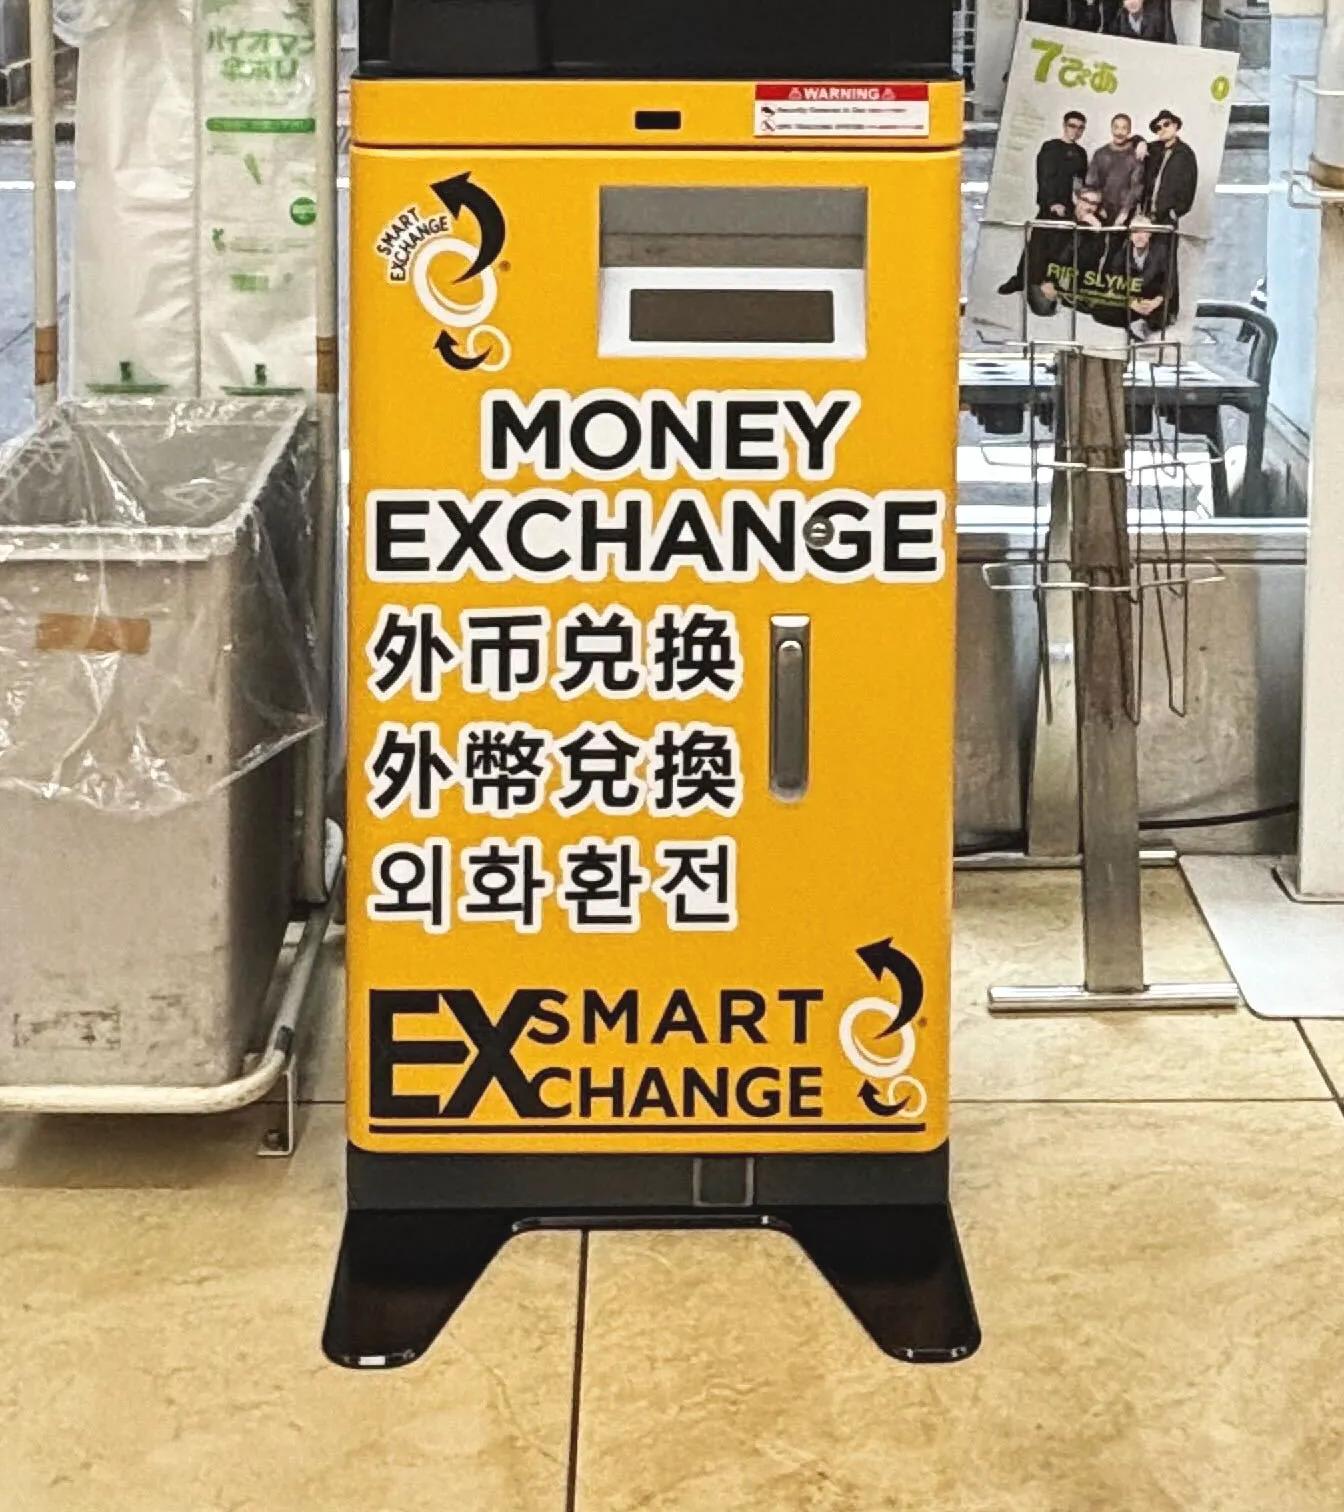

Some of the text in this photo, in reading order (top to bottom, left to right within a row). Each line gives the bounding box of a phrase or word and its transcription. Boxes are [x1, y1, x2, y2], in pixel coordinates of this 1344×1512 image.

[803, 87, 881, 100] WARNING
[376, 207, 420, 256] SMART
[390, 215, 449, 282] EXCHANGE
[490, 399, 852, 471] MONEY
[374, 499, 939, 573] EXCHANGE
[373, 844, 732, 926] 외화환전
[368, 988, 825, 1119] EX SMART
[528, 1065, 824, 1119] CHANGE
